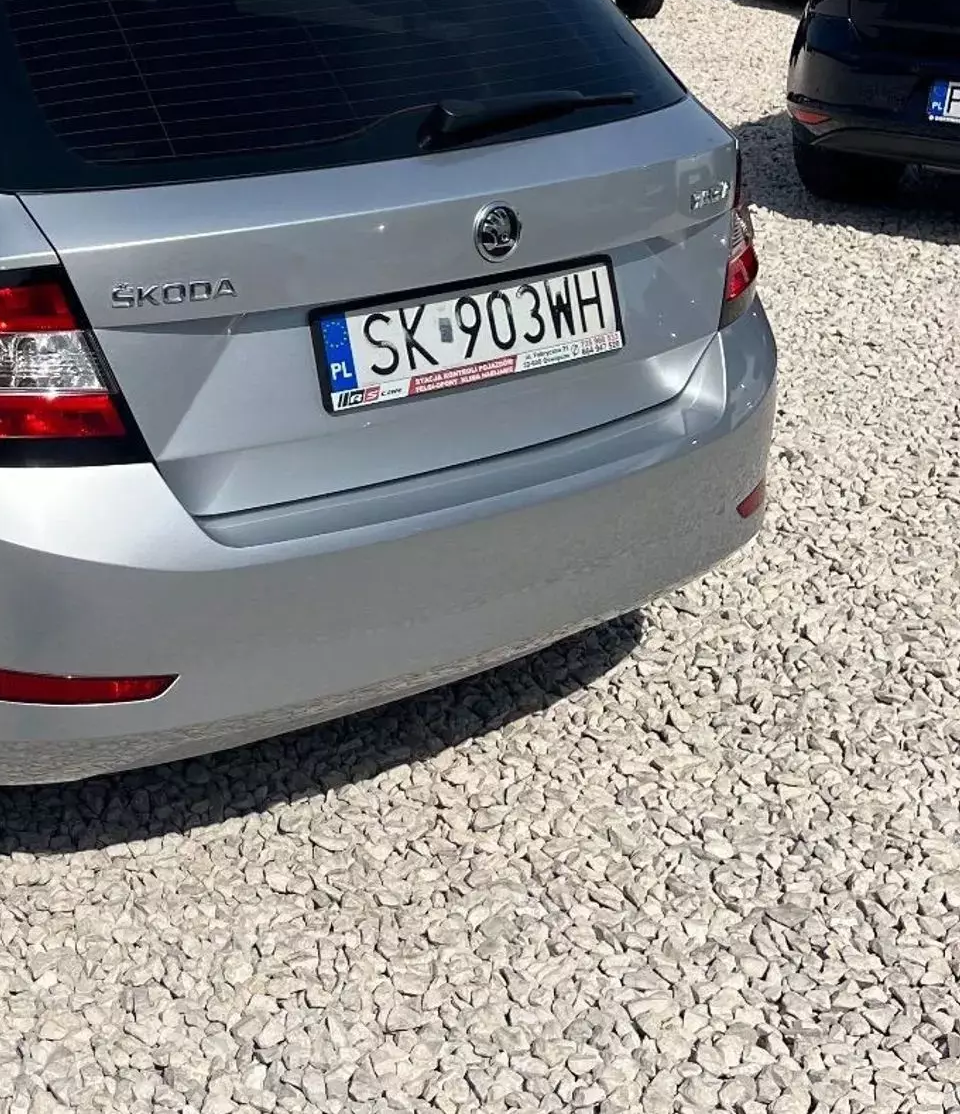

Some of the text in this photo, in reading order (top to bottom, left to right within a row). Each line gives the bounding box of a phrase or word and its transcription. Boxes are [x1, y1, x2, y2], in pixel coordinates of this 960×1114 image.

[932, 101, 943, 111] PL
[111, 277, 238, 309] ŠKODA
[362, 269, 606, 375] SK 903WH
[330, 360, 353, 381] PL
